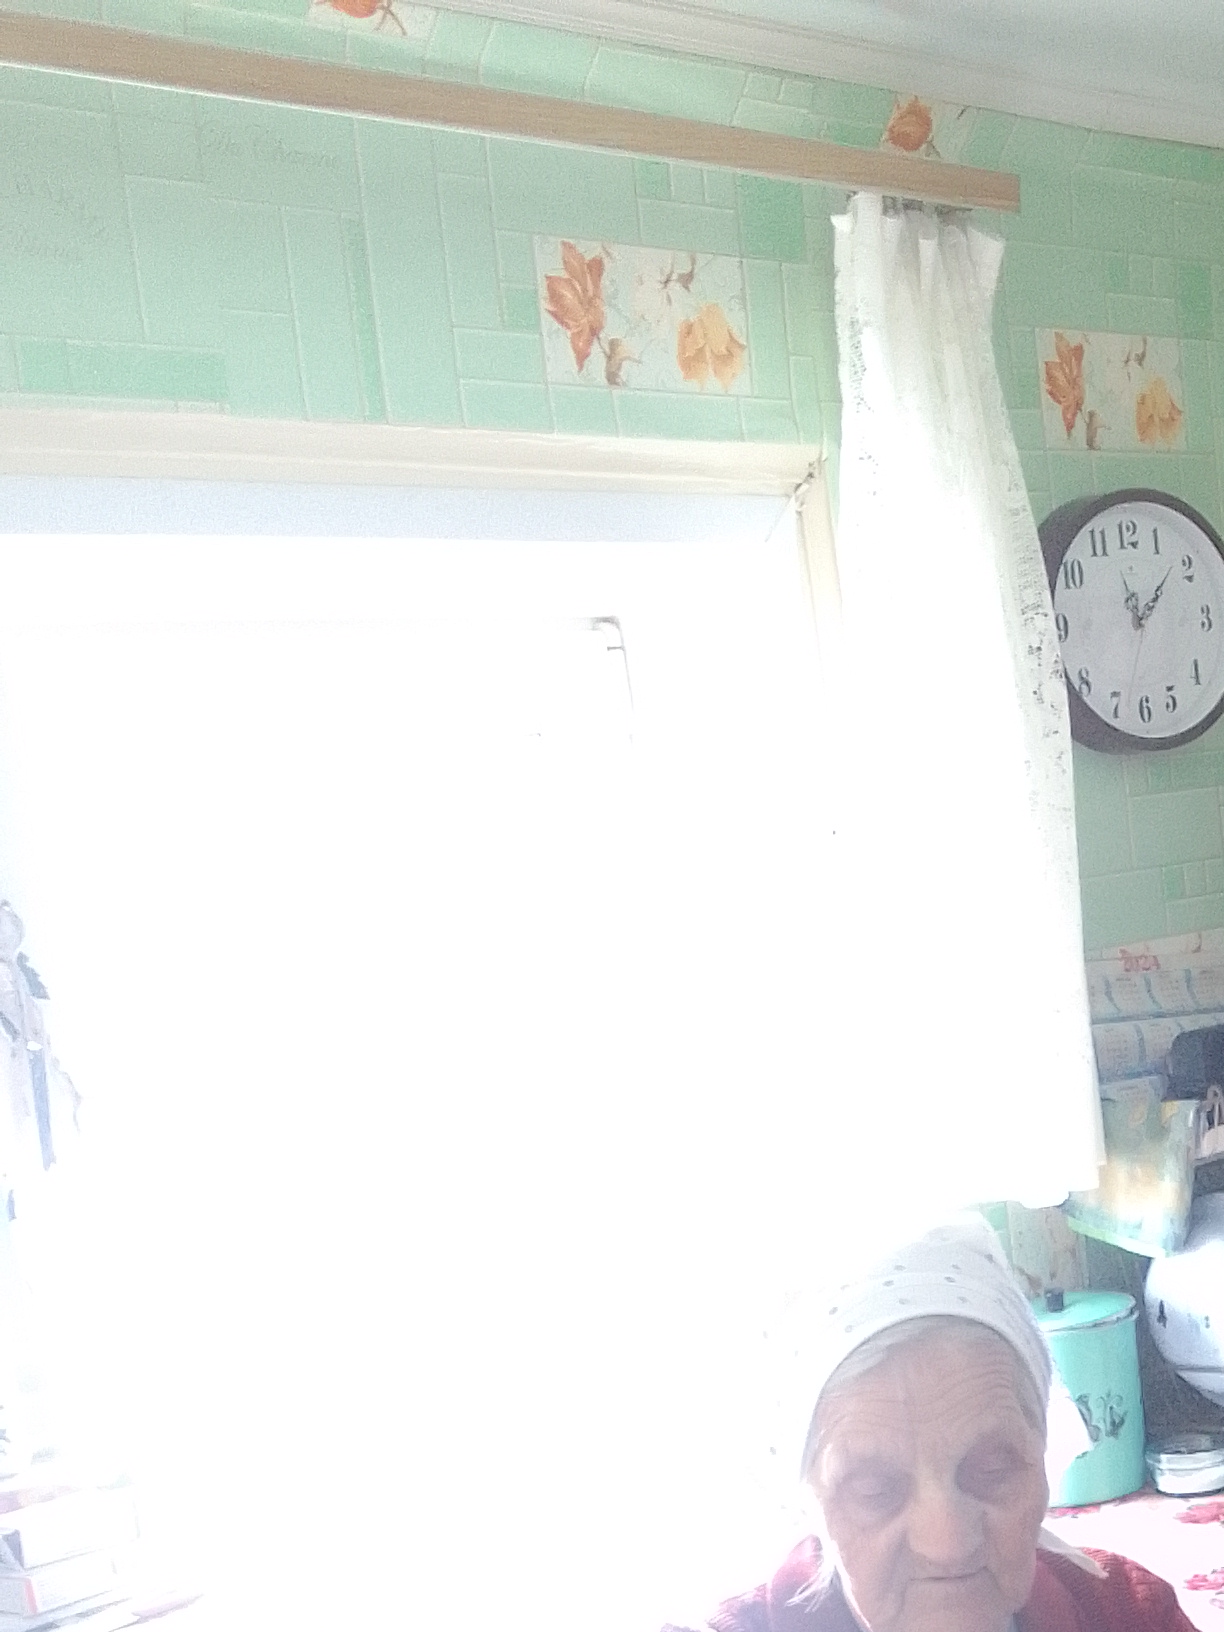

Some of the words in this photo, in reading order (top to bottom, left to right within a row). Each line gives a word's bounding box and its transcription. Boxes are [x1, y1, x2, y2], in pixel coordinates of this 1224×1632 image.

[1088, 527, 1109, 557] 11
[1117, 520, 1138, 550] 12
[1152, 527, 1160, 555] 1
[1063, 558, 1084, 589] 10
[1182, 554, 1194, 583] 2
[1055, 613, 1069, 642] 9
[1200, 604, 1212, 632] 3
[1078, 667, 1091, 697] 8
[1190, 659, 1202, 685] 4
[1110, 691, 1121, 718] 7
[1138, 695, 1152, 723] 6
[1165, 685, 1177, 713] 5
